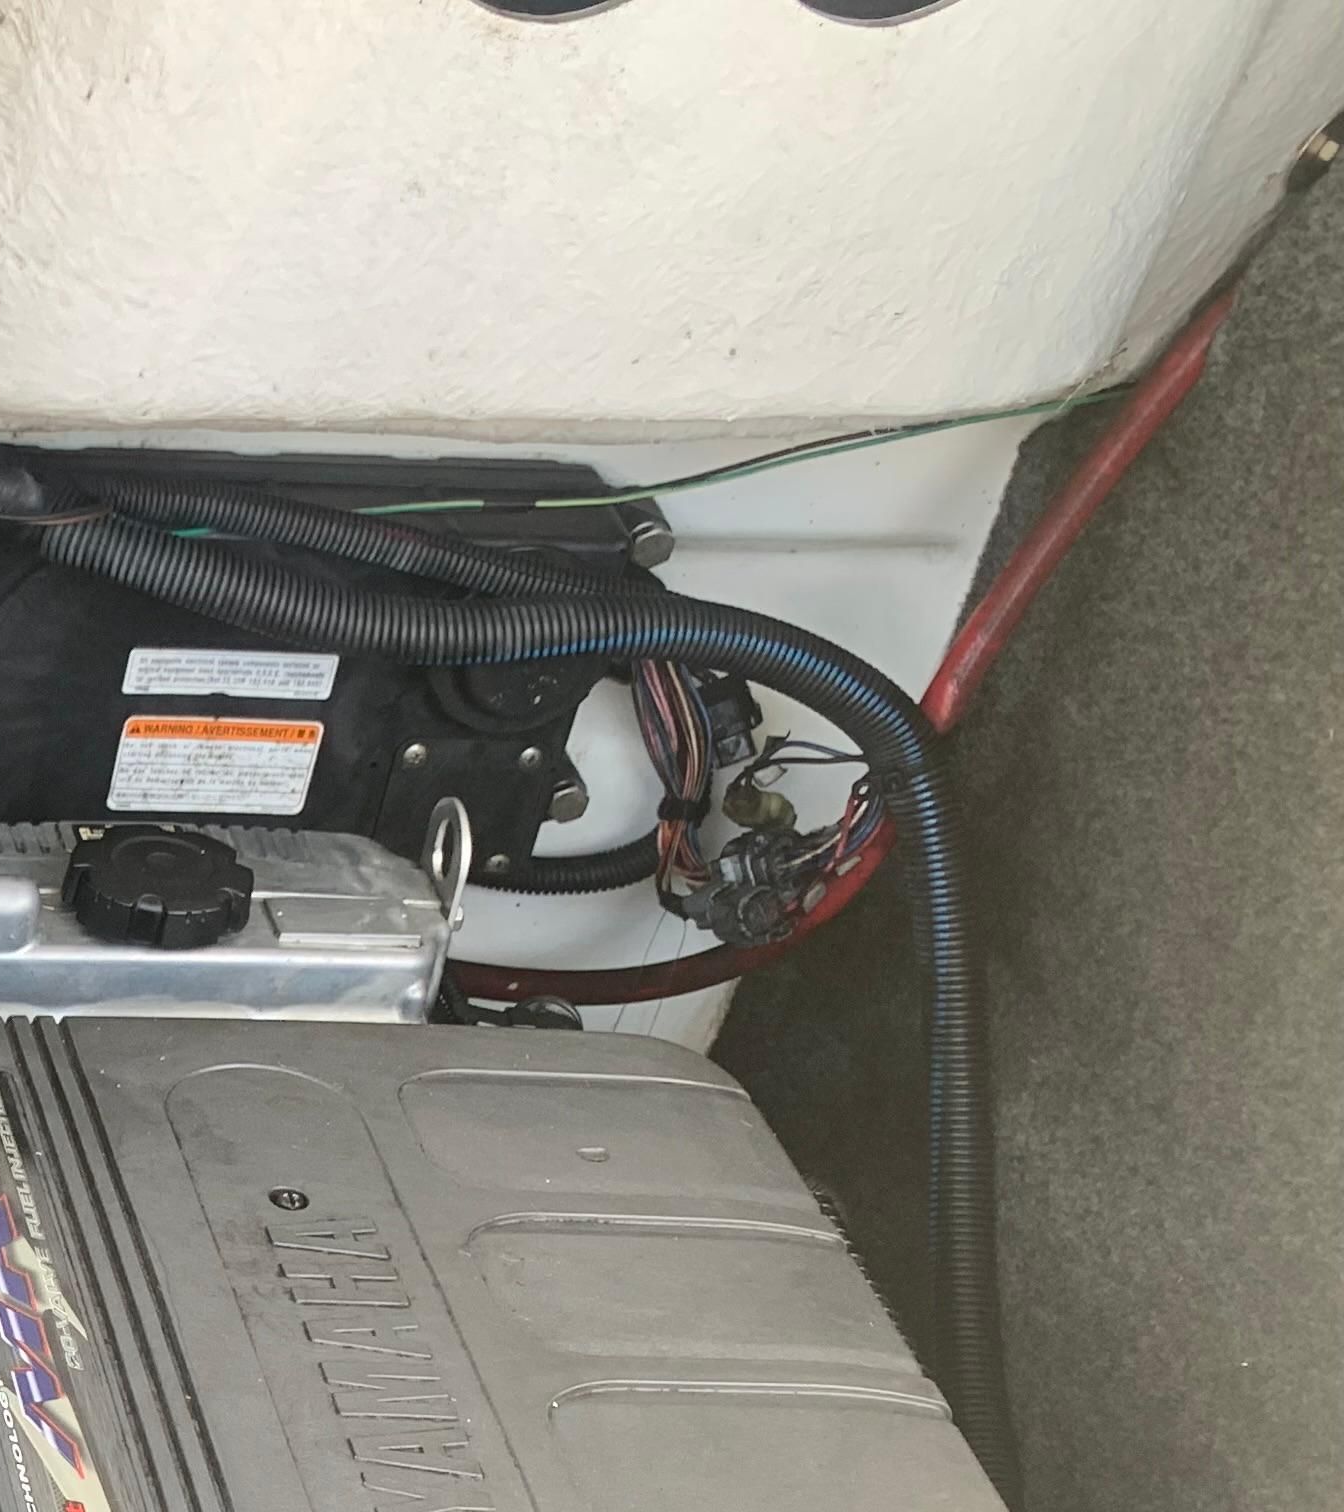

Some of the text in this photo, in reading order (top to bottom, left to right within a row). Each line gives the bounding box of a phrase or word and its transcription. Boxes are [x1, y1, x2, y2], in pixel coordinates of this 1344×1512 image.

[143, 723, 195, 736] WARNING
[202, 725, 289, 740] AVERTISSEMENT
[16, 1182, 46, 1241] FUEL
[34, 1245, 85, 1371] 20-VALVE
